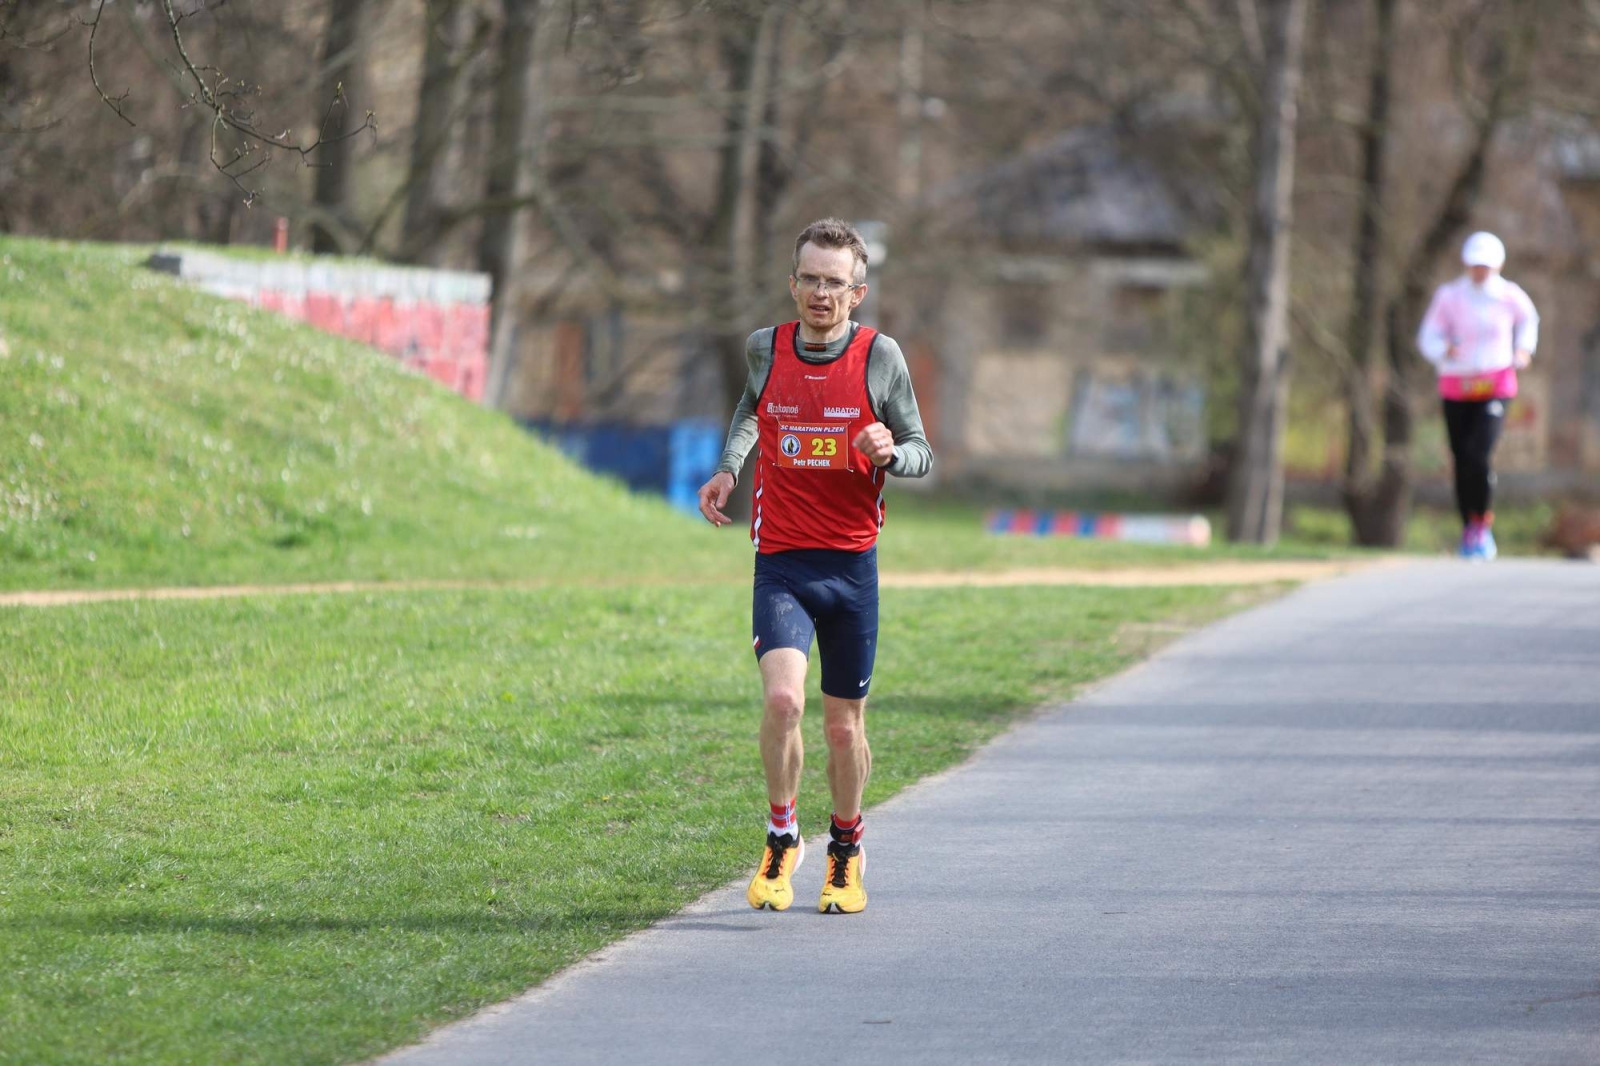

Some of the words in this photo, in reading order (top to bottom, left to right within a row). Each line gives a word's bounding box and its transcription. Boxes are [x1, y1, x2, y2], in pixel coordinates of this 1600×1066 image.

[811, 437, 837, 456] 23
[793, 458, 806, 467] Petr
[807, 459, 831, 467] PECHEK
